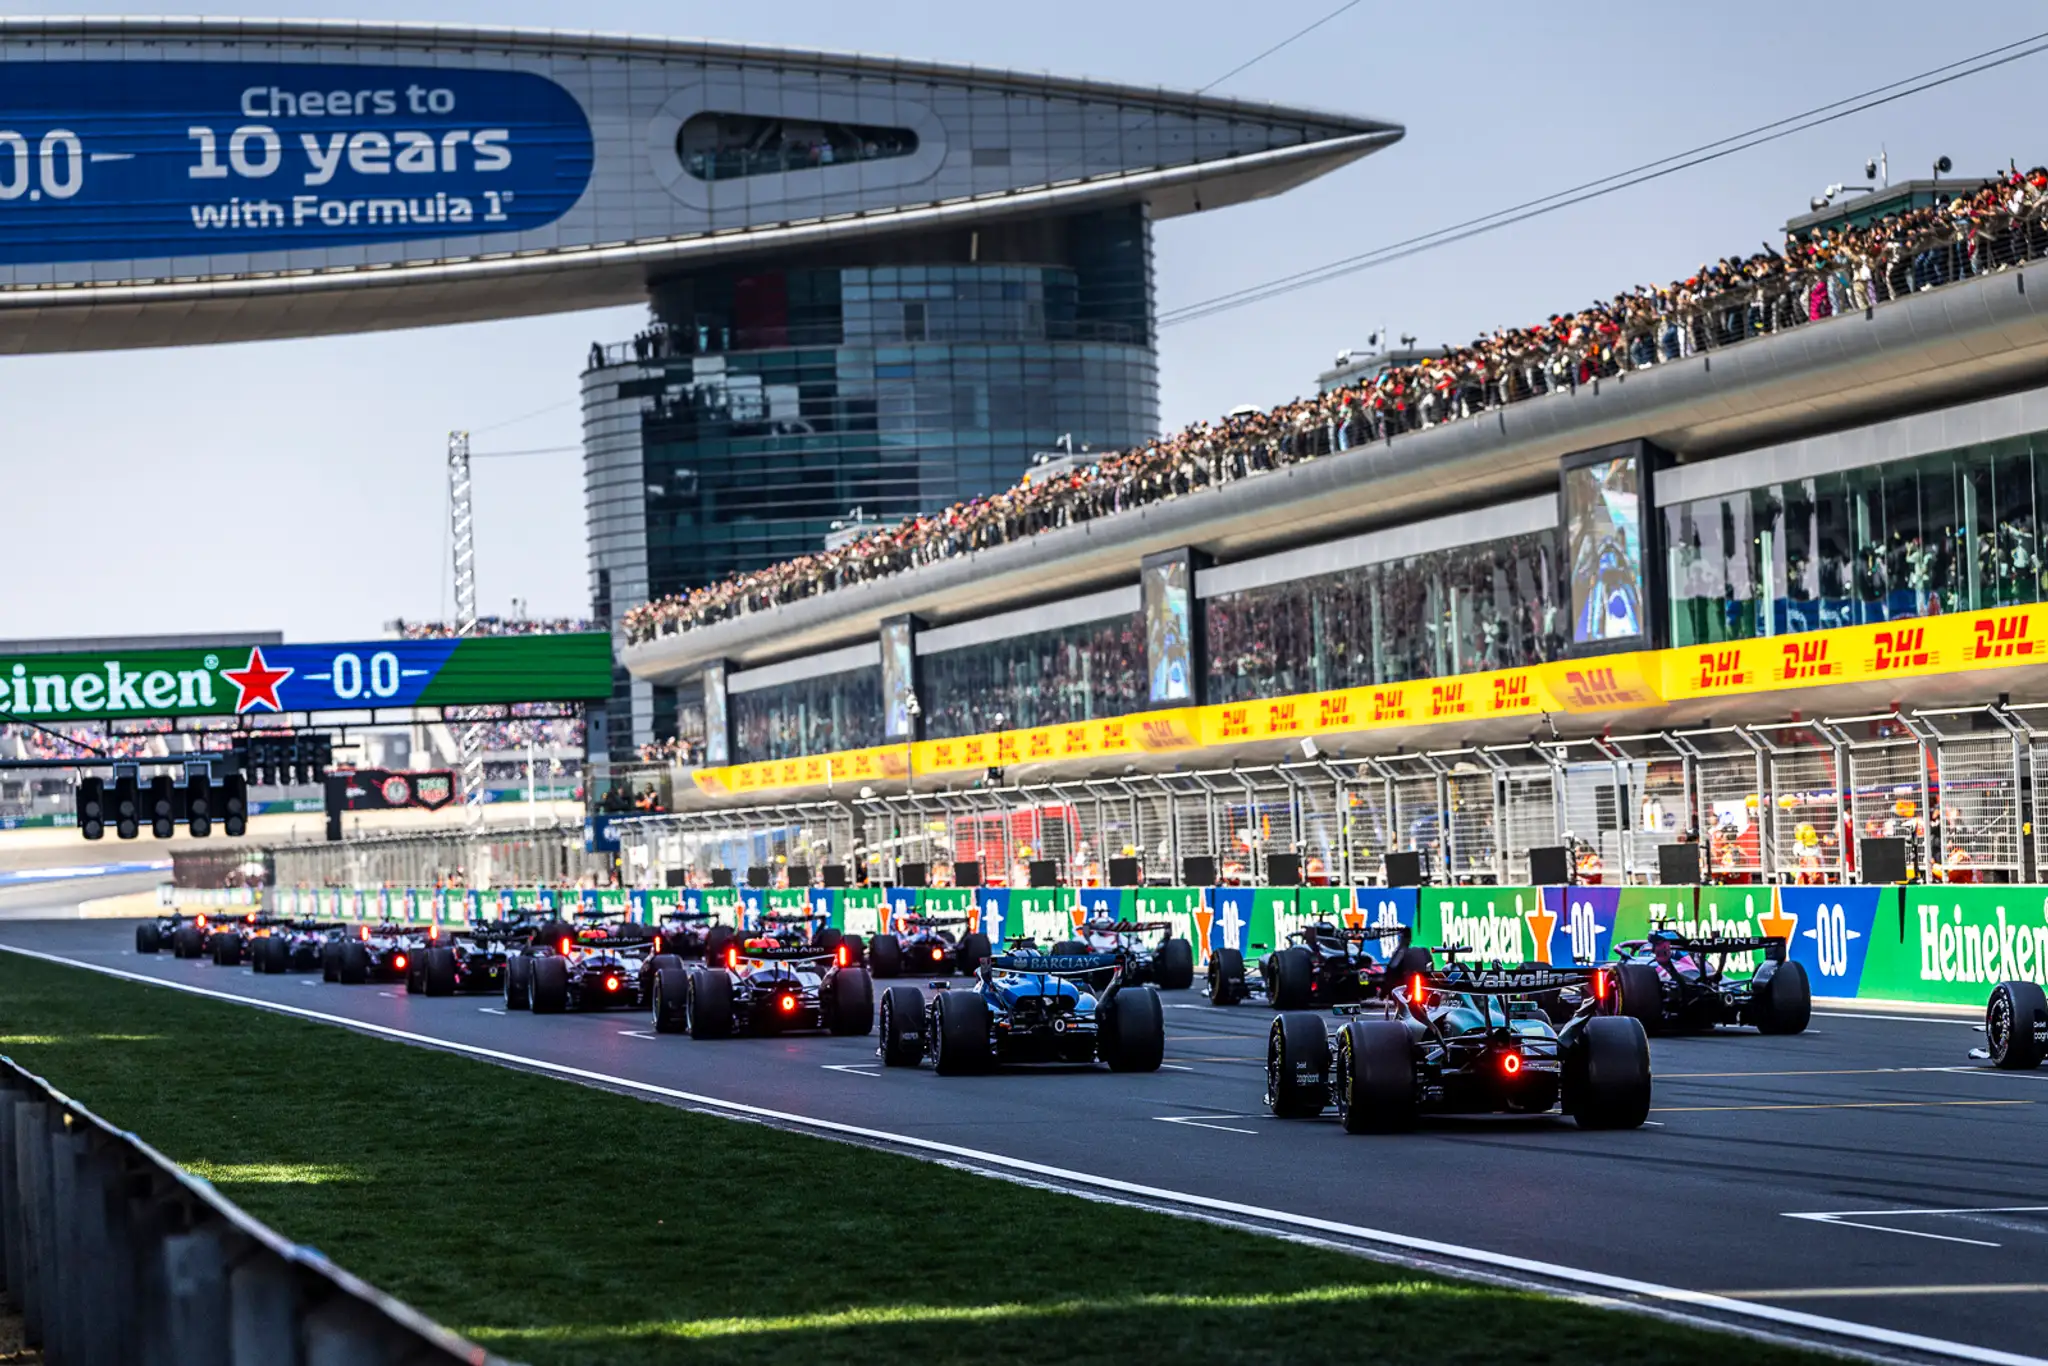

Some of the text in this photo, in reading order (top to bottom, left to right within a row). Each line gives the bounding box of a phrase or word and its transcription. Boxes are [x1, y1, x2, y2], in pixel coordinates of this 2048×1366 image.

[240, 84, 455, 117] Cheers to
[188, 124, 512, 187] 10 years
[190, 197, 285, 229] with
[292, 191, 473, 227] Formula
[1700, 615, 2034, 689] DHL DHL DHL DHL
[333, 651, 399, 699] 0.0
[1494, 675, 1530, 709] DHL
[1566, 668, 1631, 706] DHL
[766, 946, 825, 954] Cash App
[1439, 901, 1524, 964] Heineken
[1689, 937, 1759, 946] ALPINE
[1816, 903, 1848, 977] 0.0
[1031, 956, 1101, 969] BARCLAYS
[1466, 969, 1579, 988] Valvoline
